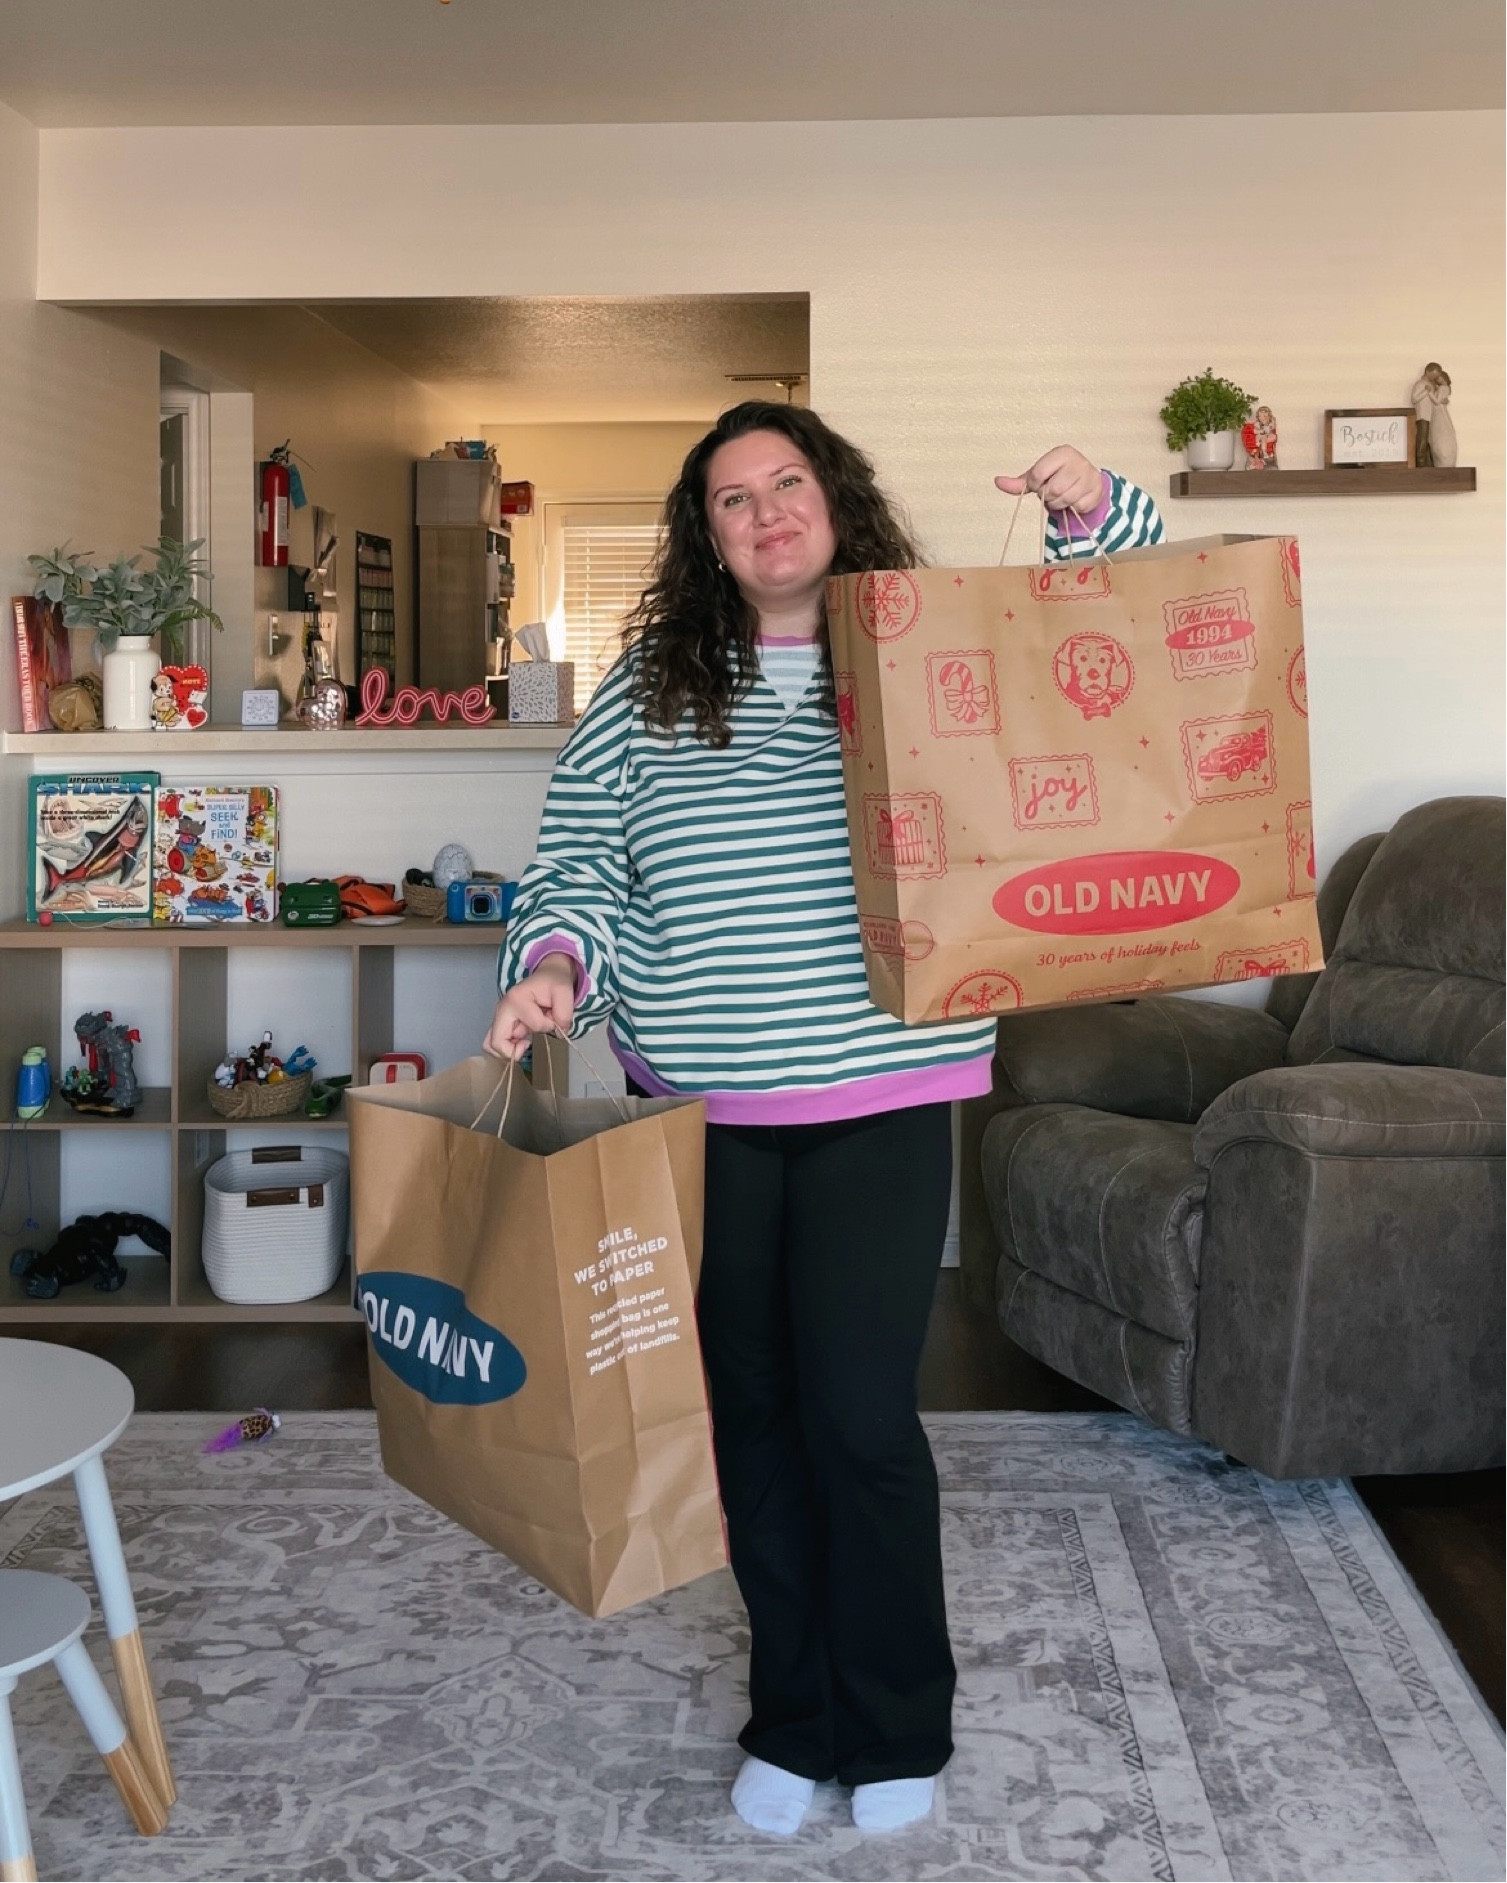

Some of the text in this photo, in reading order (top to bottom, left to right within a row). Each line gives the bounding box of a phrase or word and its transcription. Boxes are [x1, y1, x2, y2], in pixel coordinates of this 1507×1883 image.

[1178, 605, 1237, 626] Old Navy
[1185, 624, 1233, 645] 1994
[1186, 647, 1243, 667] 30 Years
[355, 665, 497, 727] love
[68, 776, 120, 784] UNCOVER
[1025, 773, 1088, 820] joy
[210, 811, 239, 822] SEEK
[1024, 869, 1212, 917] OLD NAVY
[1036, 938, 1202, 969] 30 years of holiday feels
[573, 1237, 668, 1284] WE SWITCHED
[591, 1261, 655, 1296] TO PAPER
[362, 1290, 416, 1351] OLD
[589, 1312, 606, 1323] This
[639, 1287, 665, 1303] paper
[621, 1311, 642, 1324] bag
[642, 1308, 651, 1318] is
[652, 1302, 670, 1315] one
[585, 1346, 603, 1360] way
[657, 1315, 680, 1330] keep
[589, 1354, 617, 1376] plastic
[627, 1343, 639, 1354] of
[639, 1332, 681, 1351] landfills.
